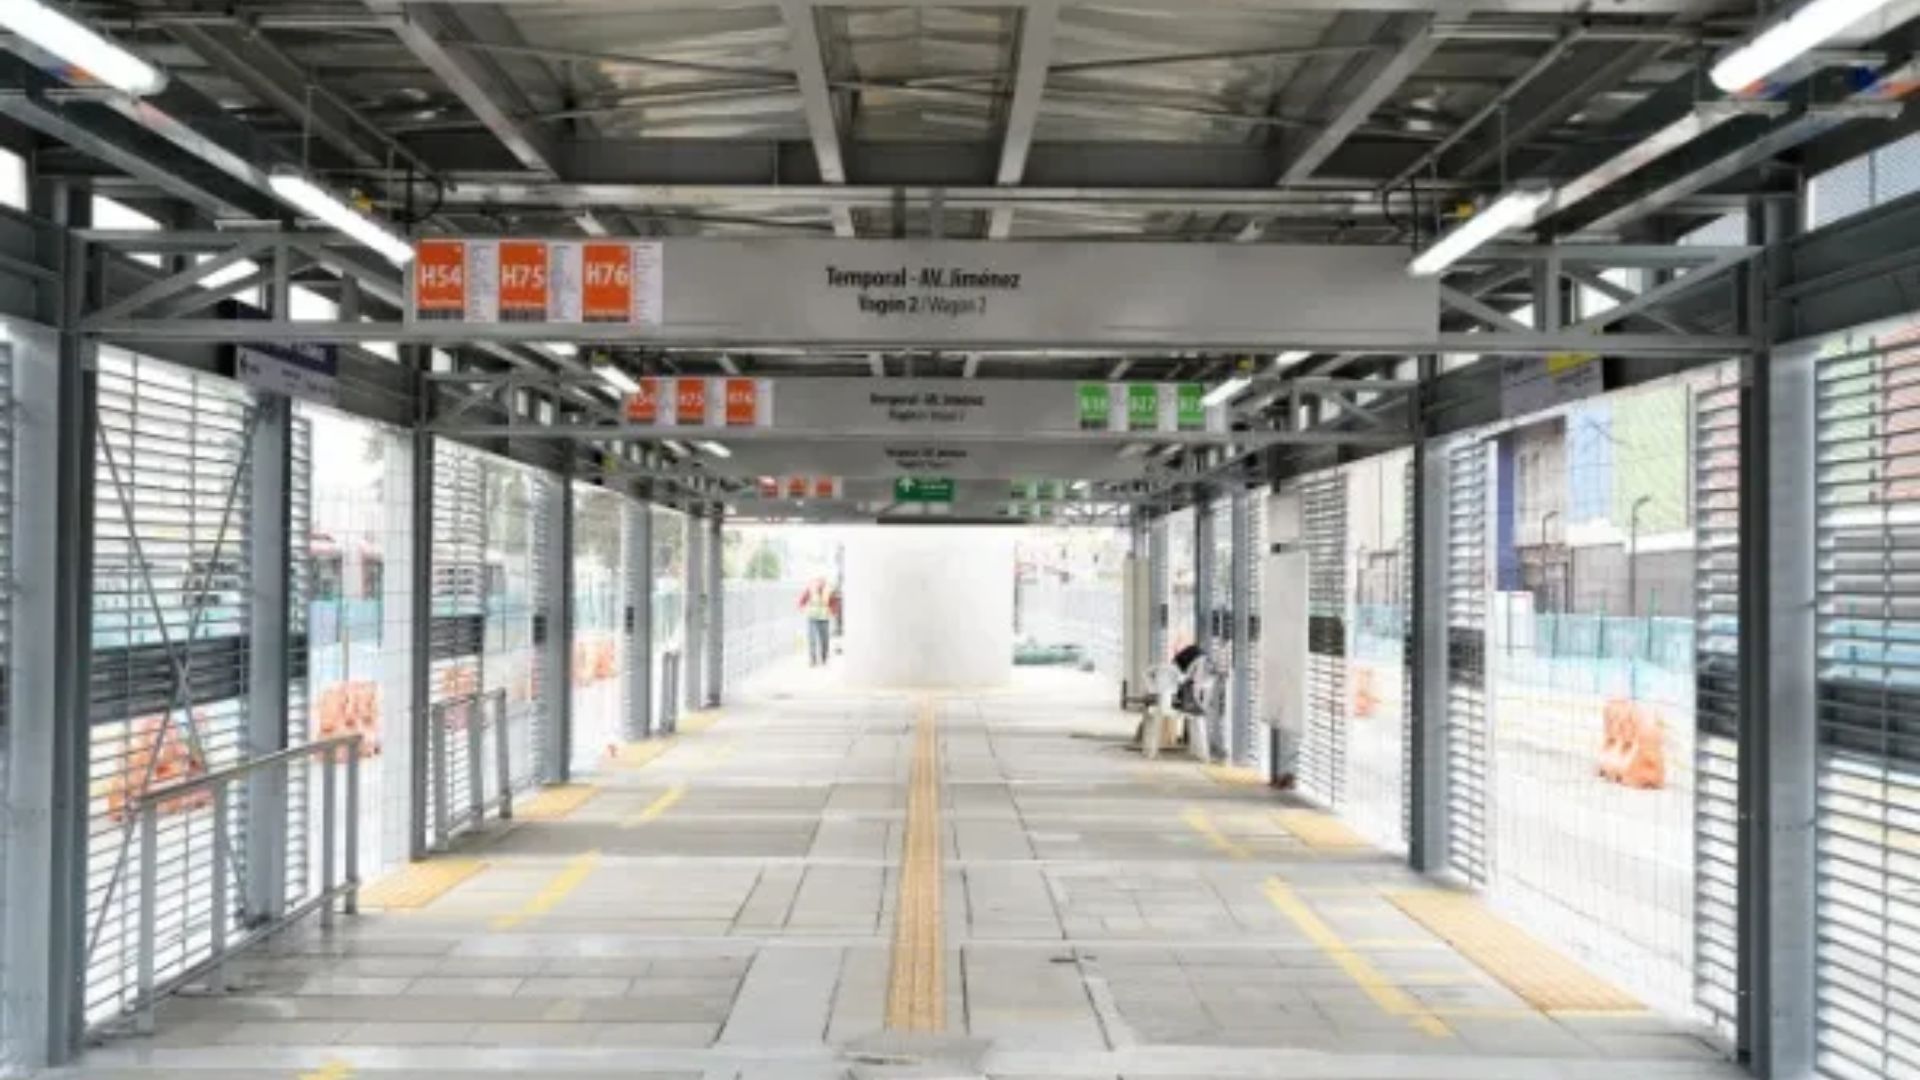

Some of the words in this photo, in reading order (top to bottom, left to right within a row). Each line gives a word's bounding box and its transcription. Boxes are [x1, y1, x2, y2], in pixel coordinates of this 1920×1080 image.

[421, 265, 463, 288] H54
[501, 265, 545, 288] H75
[585, 262, 629, 285] H76
[826, 266, 906, 289] Temporal
[950, 267, 1021, 289] Jiménez
